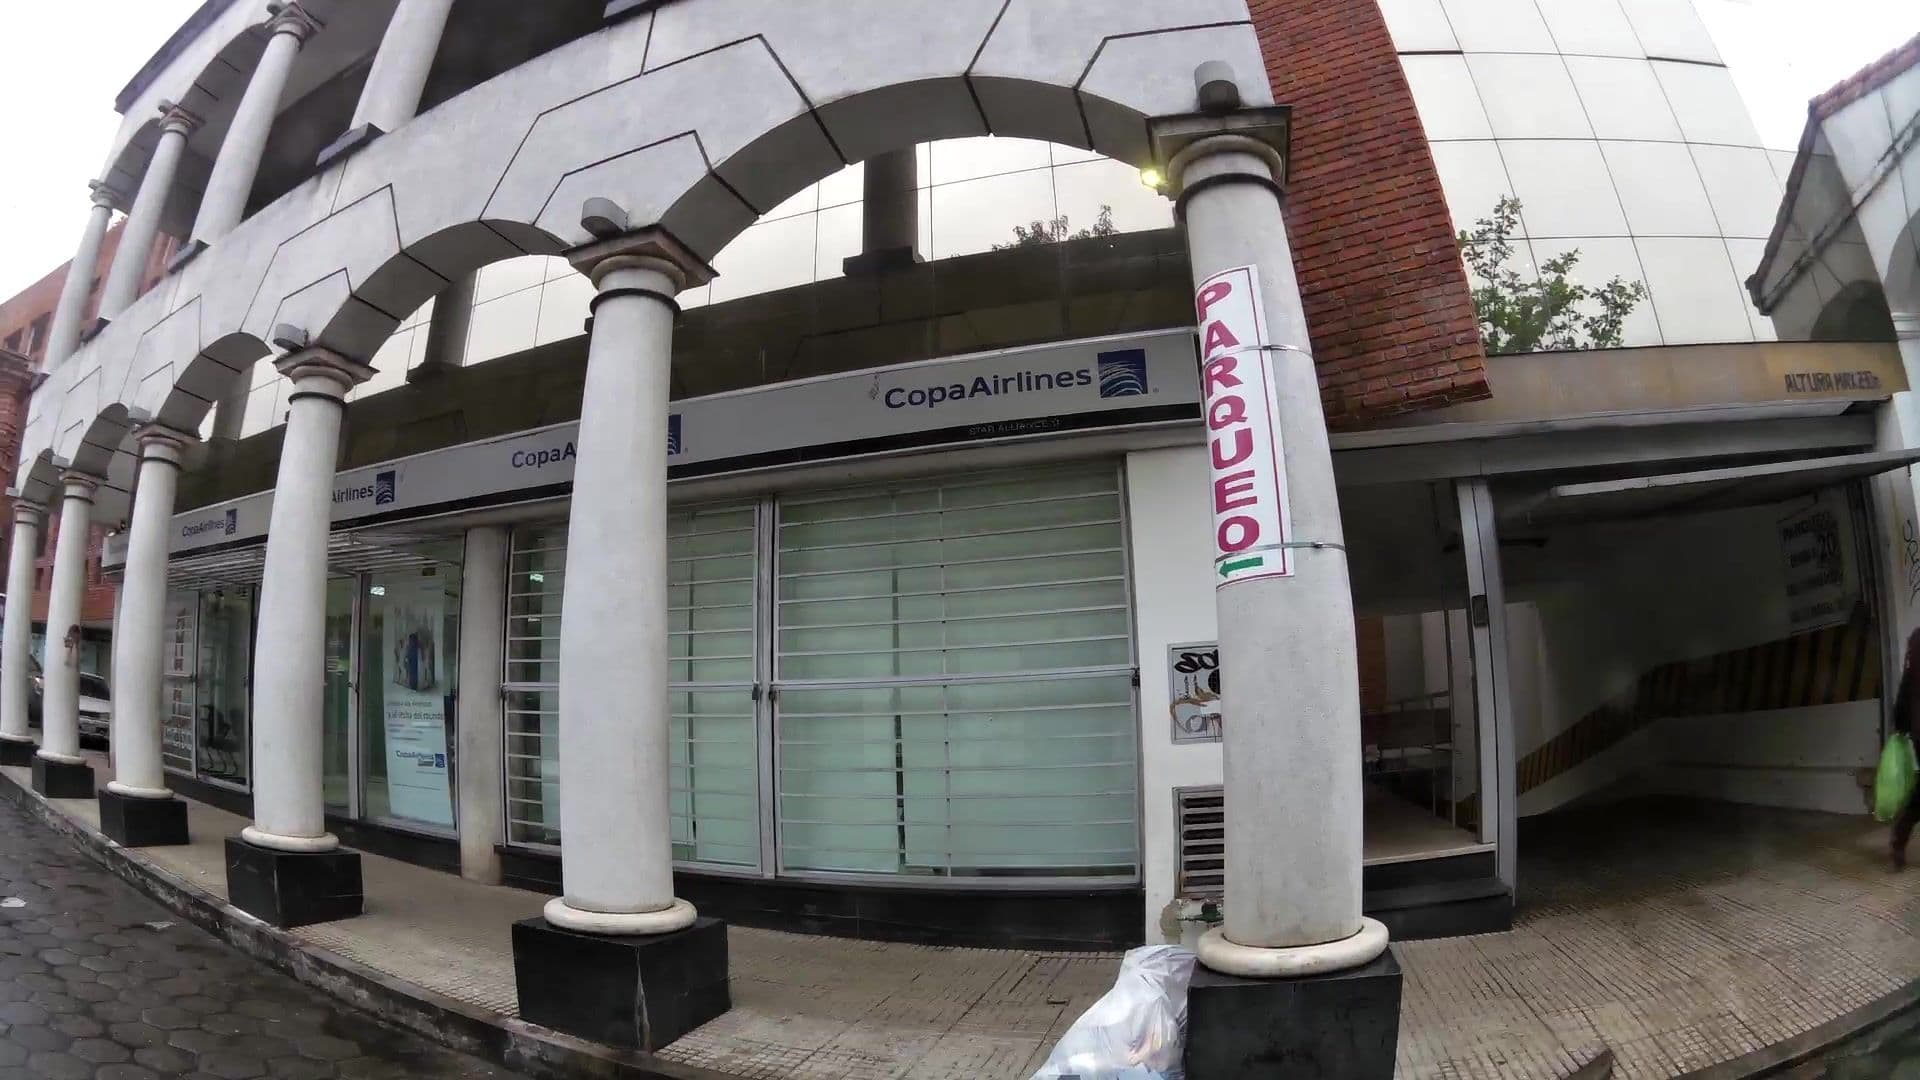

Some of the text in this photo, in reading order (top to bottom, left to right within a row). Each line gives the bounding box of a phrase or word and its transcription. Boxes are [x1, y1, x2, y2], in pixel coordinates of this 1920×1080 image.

[884, 367, 1092, 408] CopaAirlines
[1196, 281, 1261, 554] PARQUEO
[512, 442, 577, 469] CopaA
[332, 483, 375, 505] Airlines
